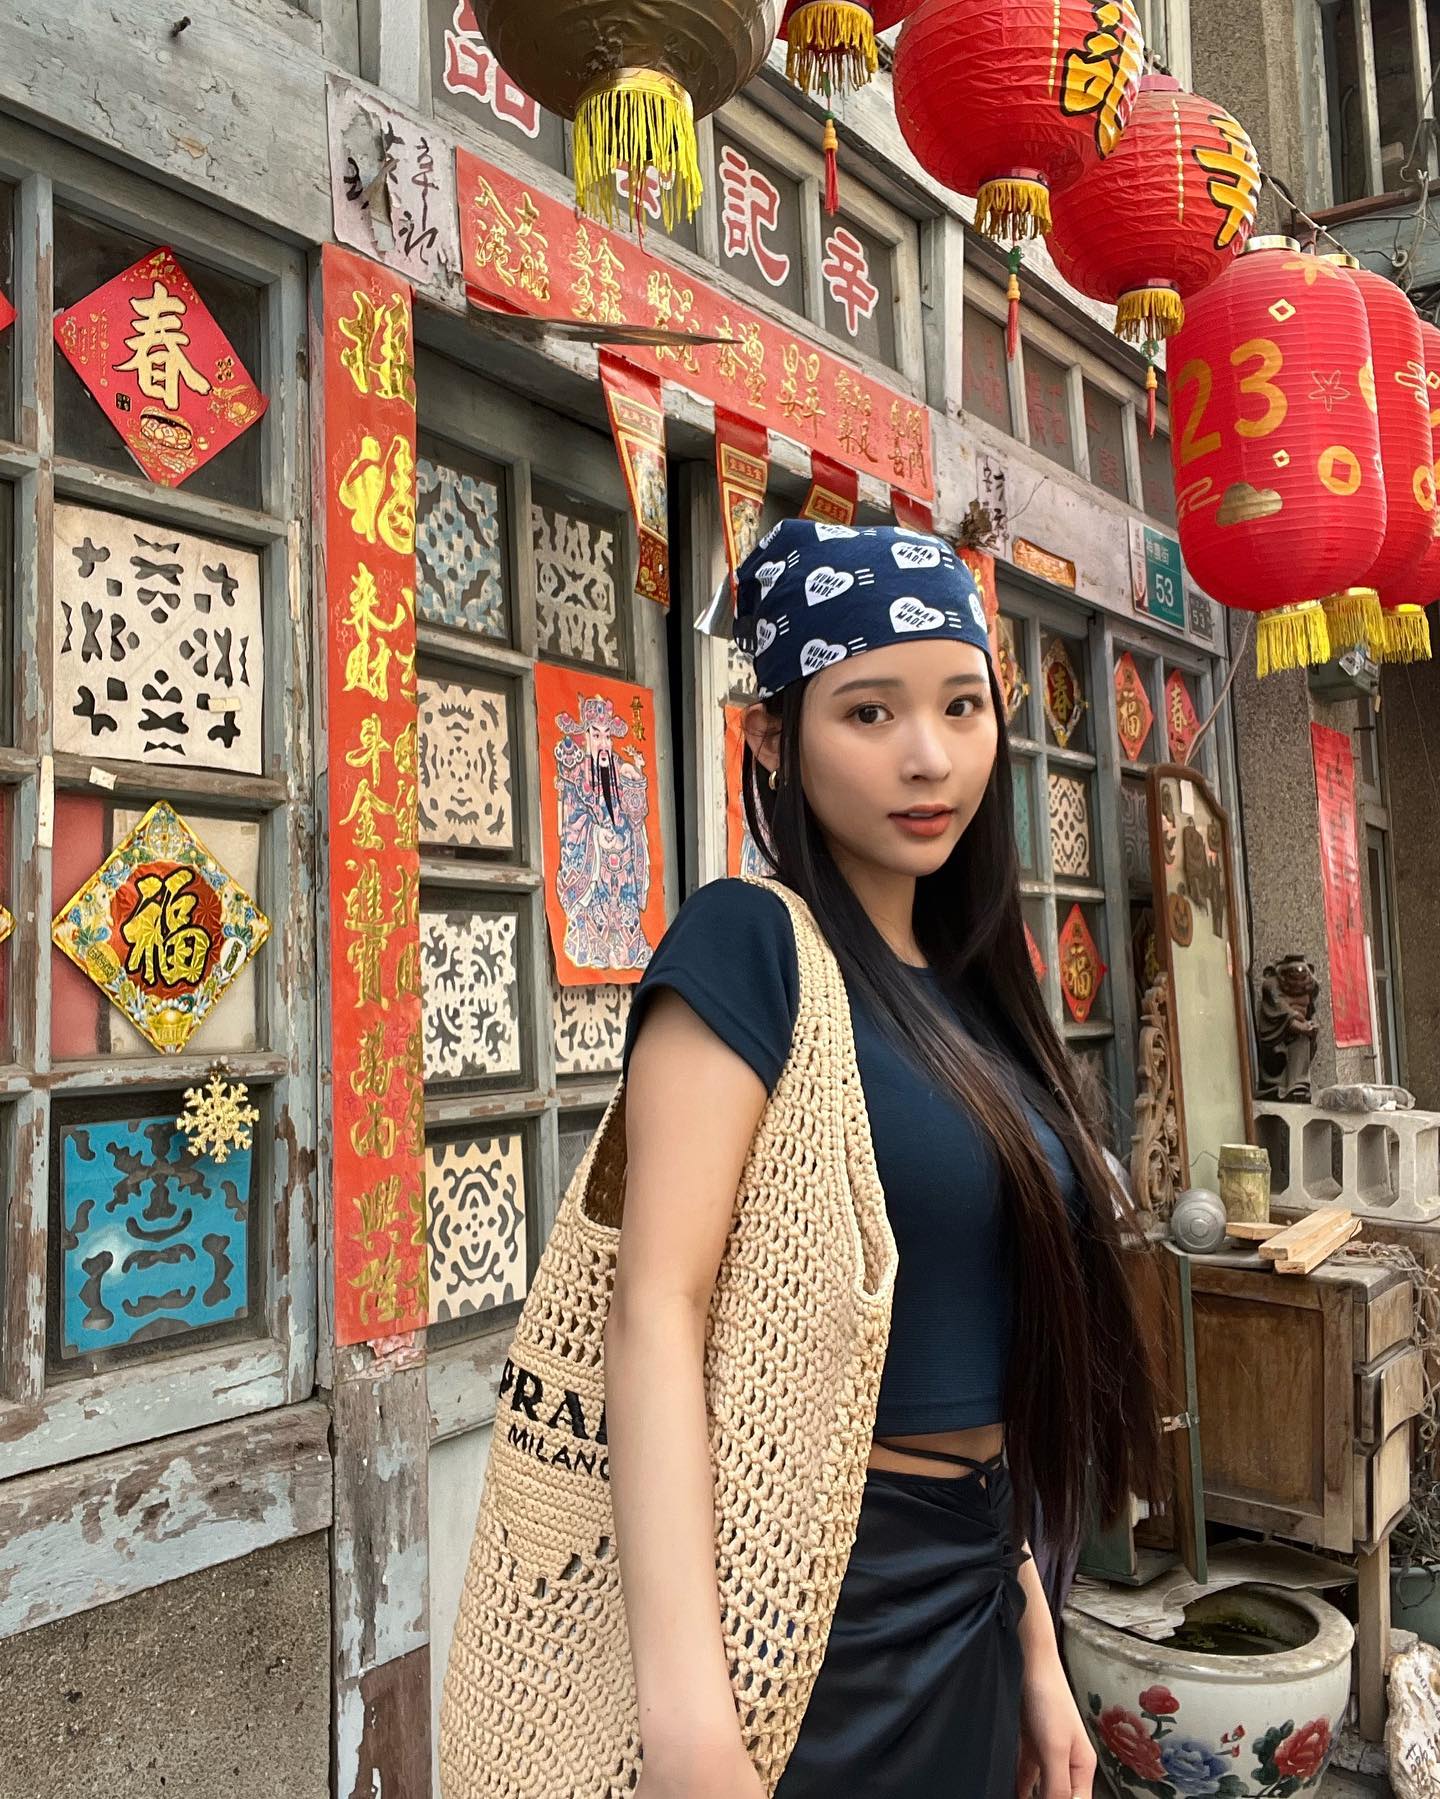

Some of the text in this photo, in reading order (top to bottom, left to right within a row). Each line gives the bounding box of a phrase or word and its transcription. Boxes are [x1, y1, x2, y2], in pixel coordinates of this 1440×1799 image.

[718, 145, 790, 288] 記
[821, 226, 879, 337] 辛
[112, 280, 213, 411] 春
[1177, 338, 1289, 465] 23
[808, 582, 834, 598] MADE
[813, 572, 847, 589] HUMAN
[1155, 573, 1176, 608] 53
[894, 611, 926, 629] MADE
[899, 602, 937, 623] HUMAN
[806, 645, 841, 662] HUMAN
[121, 866, 214, 987] 福
[499, 1357, 609, 1446] PRA
